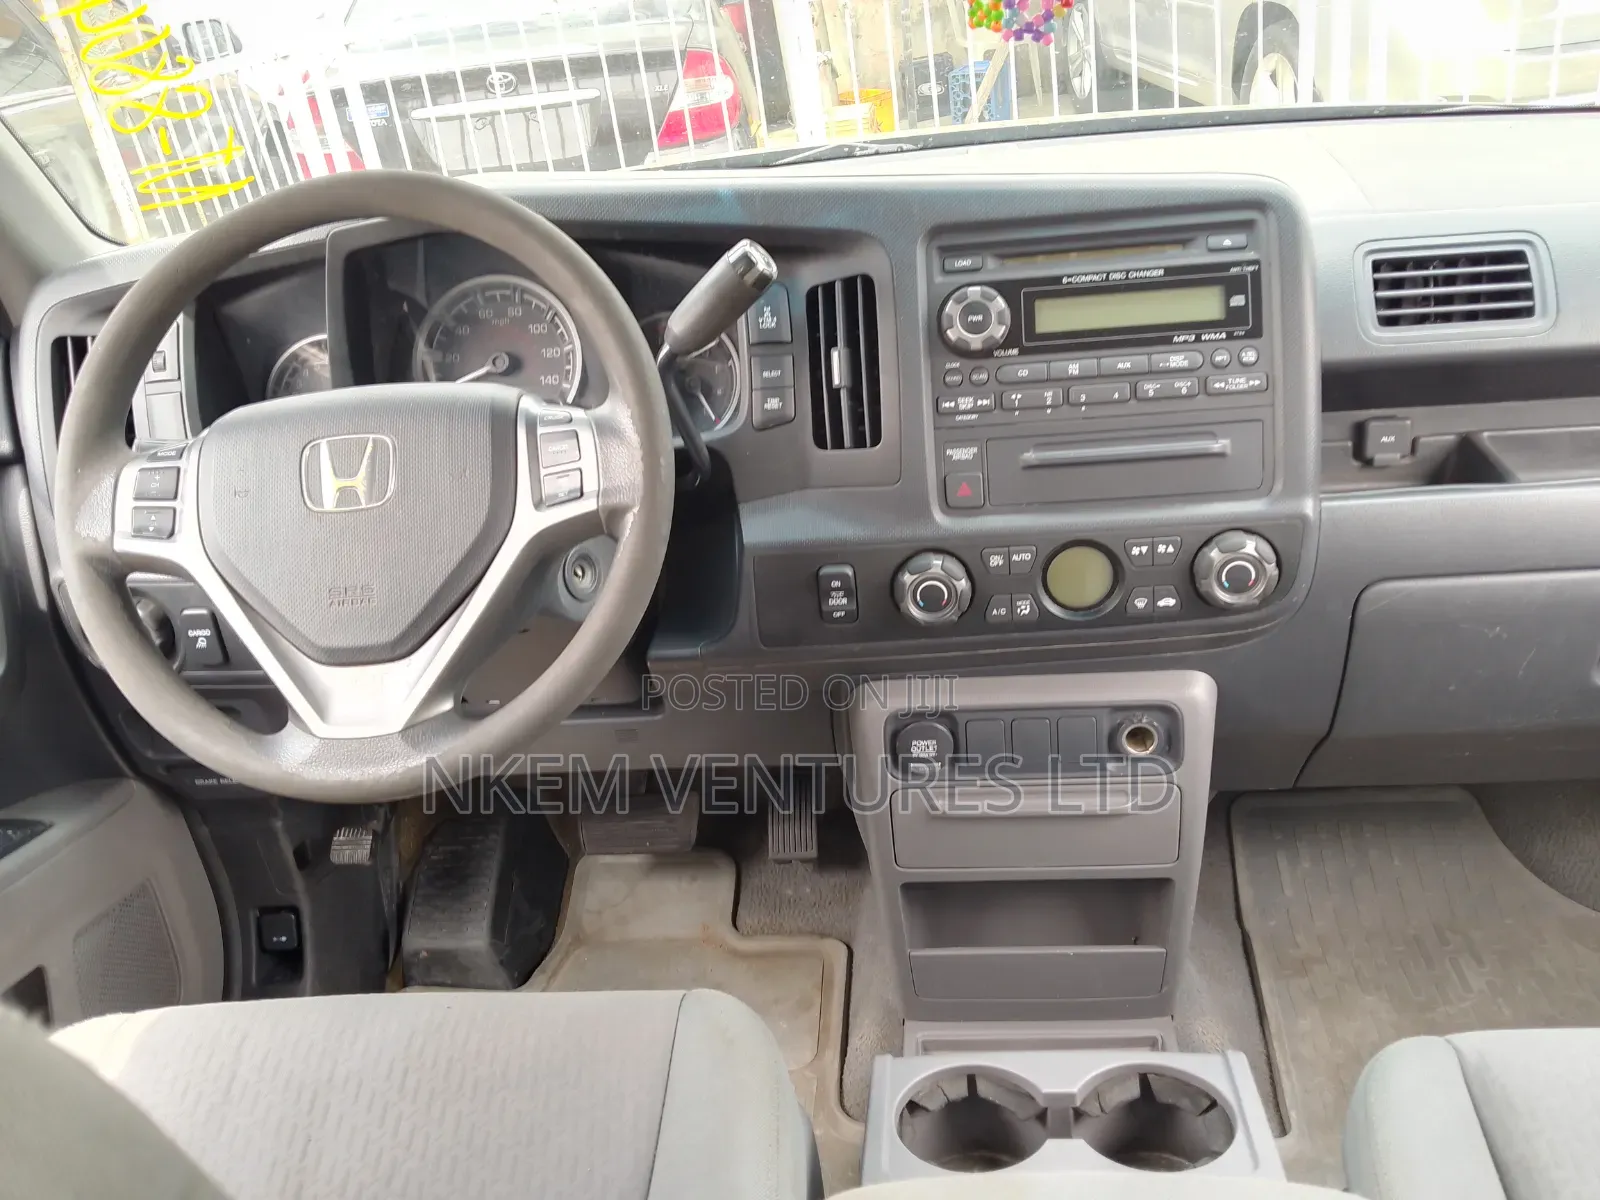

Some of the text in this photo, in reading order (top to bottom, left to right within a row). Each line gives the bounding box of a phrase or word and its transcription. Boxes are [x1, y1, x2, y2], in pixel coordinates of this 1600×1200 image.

[954, 260, 972, 268] LOAD
[1109, 271, 1126, 281] DISC
[1128, 268, 1165, 279] CHANGER
[492, 317, 510, 326] mph
[968, 314, 984, 323] PWR
[528, 323, 548, 334] 100
[1173, 333, 1196, 344] MP3
[1201, 331, 1227, 342] WMA
[541, 347, 561, 358] 120
[993, 347, 1020, 358] VOLUME
[1068, 362, 1079, 370] AM
[1117, 361, 1131, 370] AUX
[1018, 369, 1028, 378] CD
[540, 376, 560, 386] 140
[1228, 376, 1247, 384] TUNE
[1112, 391, 1119, 400] 4
[1181, 387, 1188, 395] 6
[1080, 394, 1086, 402] 3
[946, 446, 978, 456] PASSENGER
[1012, 552, 1032, 562] AUTO
[990, 560, 1004, 568] OFF
[830, 580, 841, 588] ON
[828, 597, 848, 606] DOOR
[832, 610, 846, 618] OFF
[992, 608, 1006, 616] A/C
[188, 628, 211, 638] CARGO
